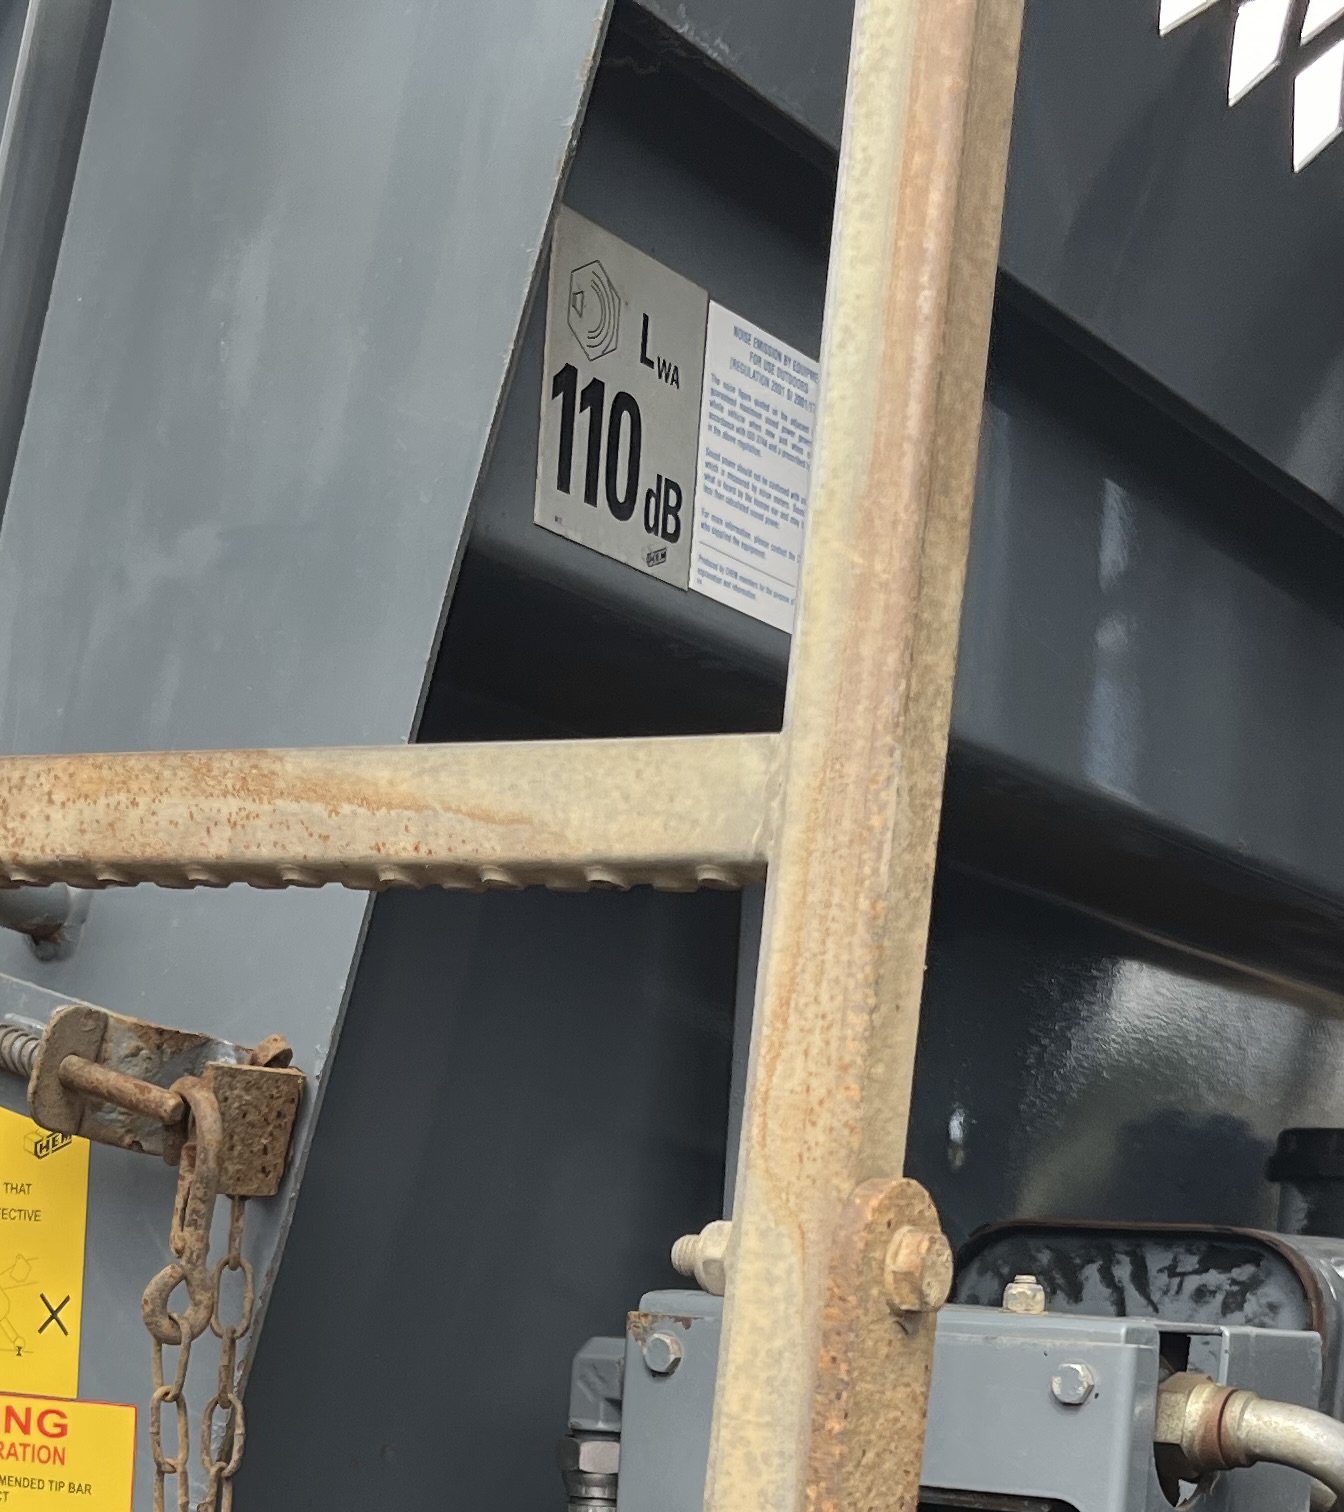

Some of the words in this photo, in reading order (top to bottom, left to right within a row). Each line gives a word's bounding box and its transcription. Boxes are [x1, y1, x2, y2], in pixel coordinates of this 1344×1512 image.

[551, 363, 642, 521] 110
[644, 474, 682, 544] dB
[4, 1182, 32, 1195] THAT
[48, 1480, 66, 1493] TIP
[68, 1482, 92, 1495] BAR
